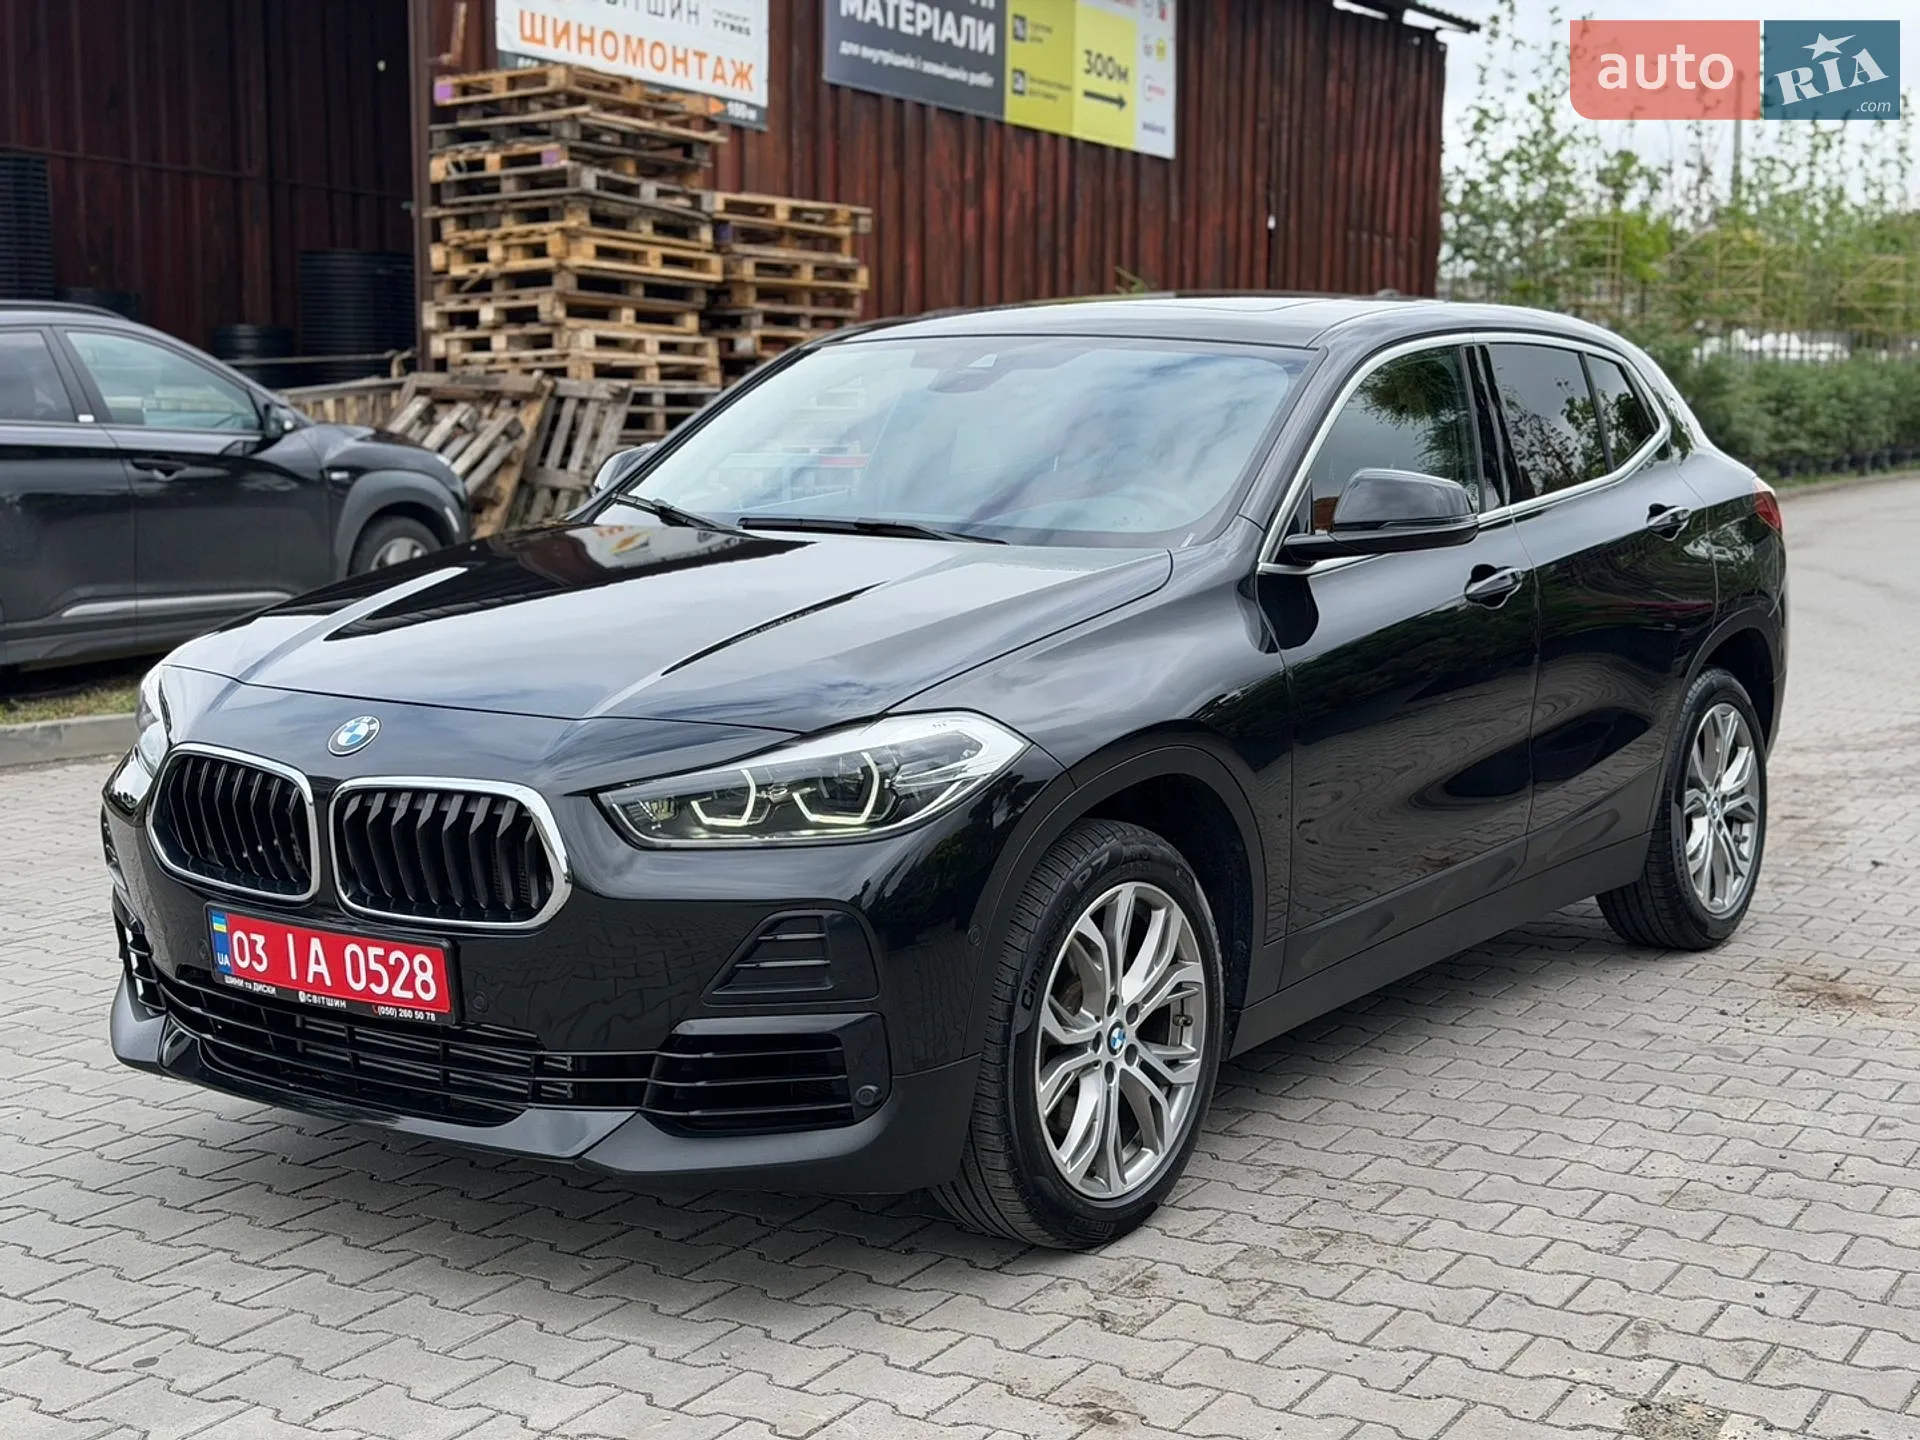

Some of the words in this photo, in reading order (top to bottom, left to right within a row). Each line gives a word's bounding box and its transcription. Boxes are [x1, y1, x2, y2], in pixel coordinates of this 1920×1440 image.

[518, 9, 755, 92] ШИНОМОНТАЖ
[1083, 49, 1129, 85] 300м
[216, 953, 231, 968] UA
[232, 930, 269, 973] 03
[286, 933, 332, 987] IA
[344, 943, 437, 1001] 0528
[377, 1005, 397, 1018] (050)
